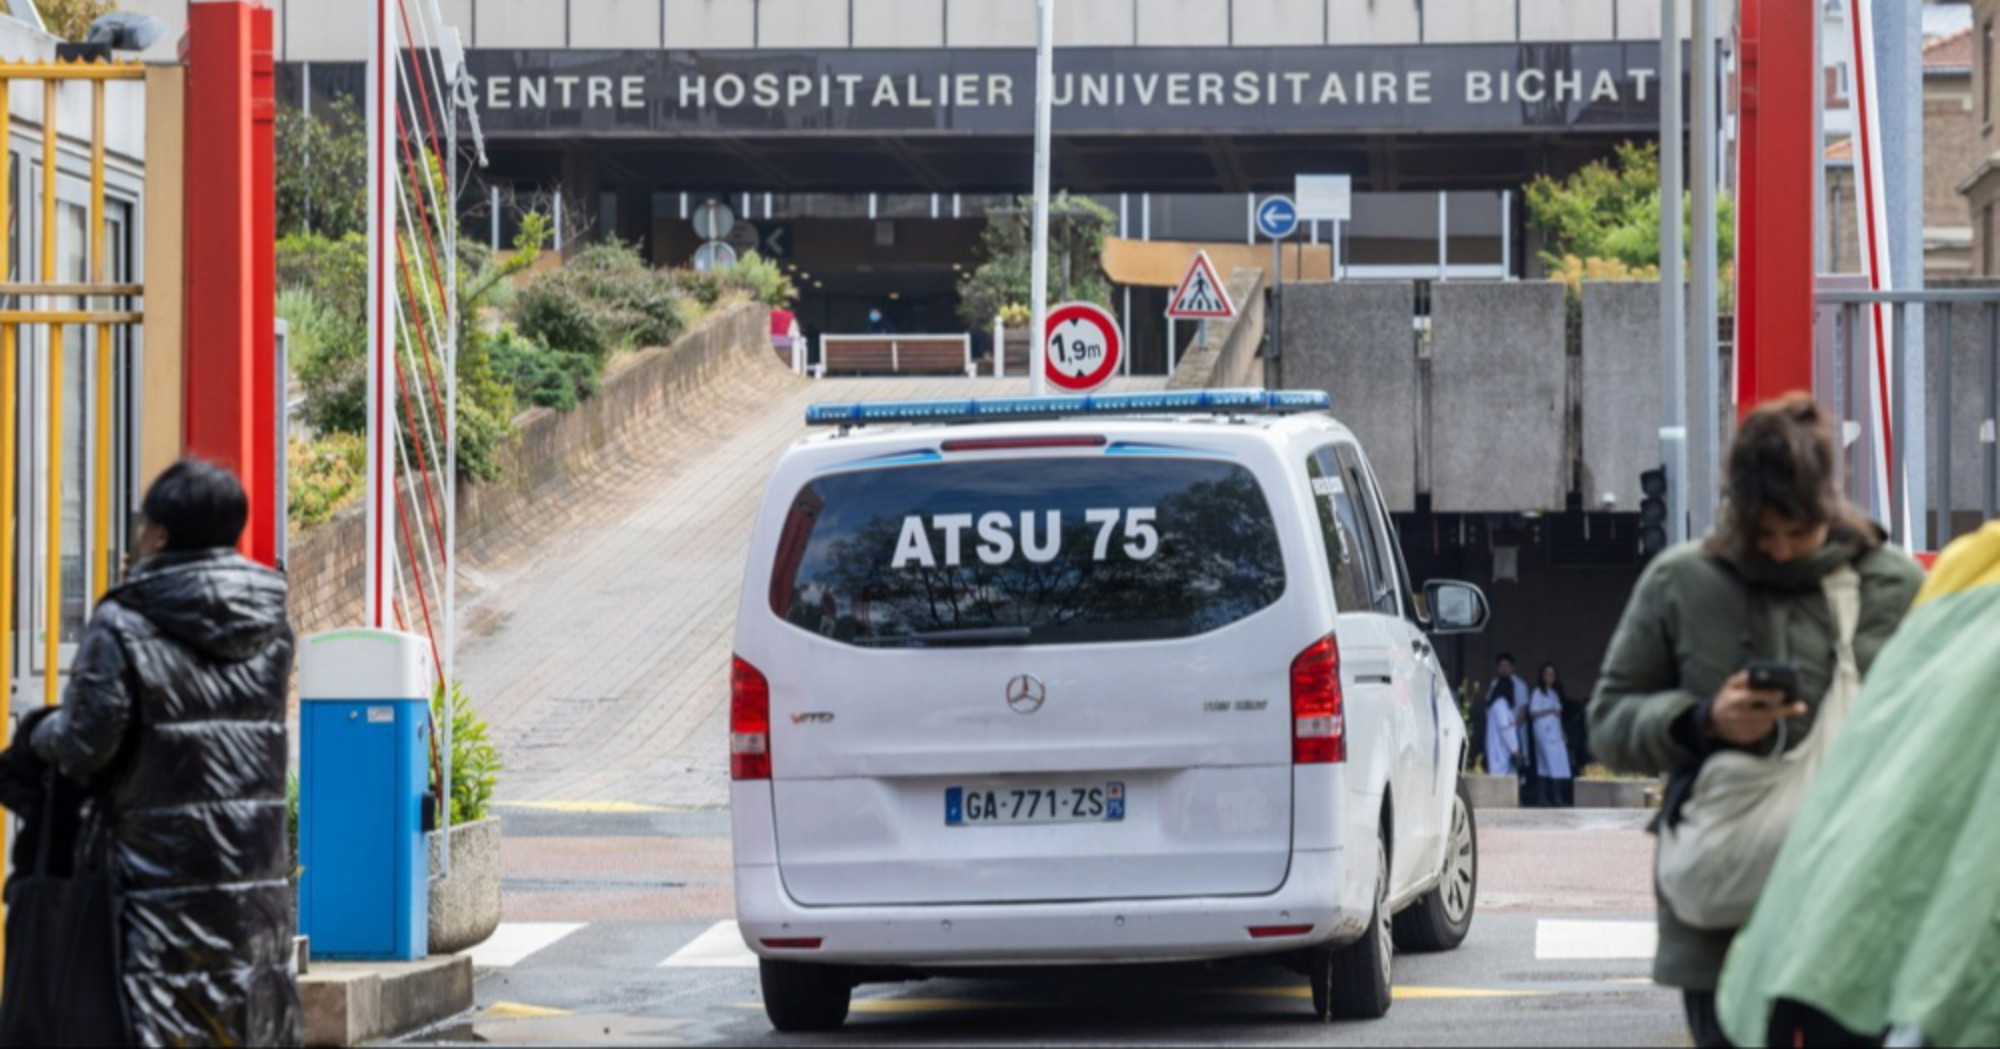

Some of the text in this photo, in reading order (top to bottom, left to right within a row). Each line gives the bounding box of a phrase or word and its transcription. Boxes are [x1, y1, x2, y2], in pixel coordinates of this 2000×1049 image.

[452, 68, 1656, 108] CENTRE HOSPITALIER UNIVERSITAIRE BICHAT
[891, 507, 1160, 568] ATSU 75
[966, 788, 1104, 820] GA-771-ZS
